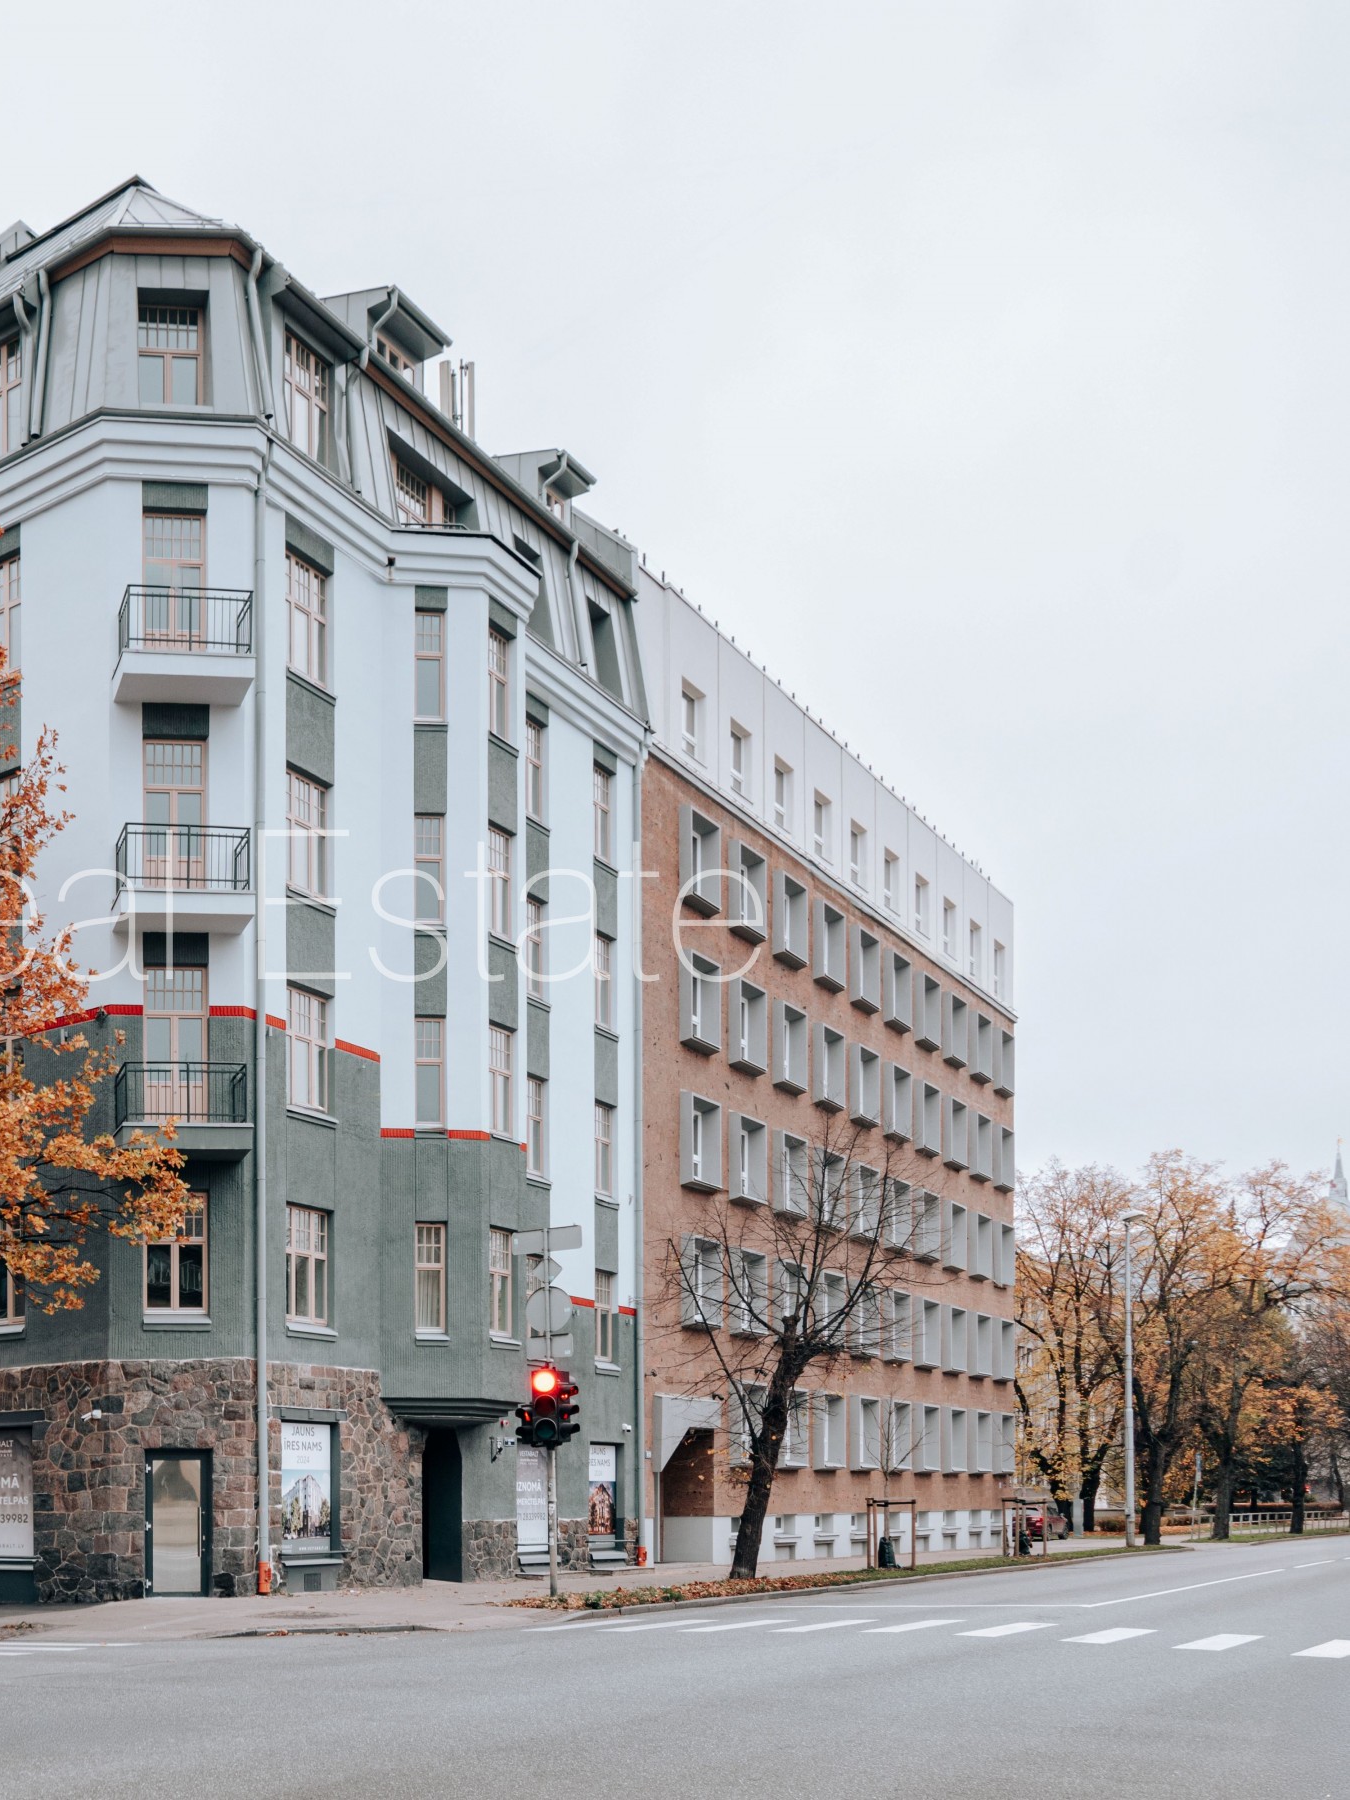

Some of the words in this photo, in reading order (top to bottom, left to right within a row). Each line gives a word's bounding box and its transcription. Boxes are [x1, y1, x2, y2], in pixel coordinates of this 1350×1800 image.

[291, 1425, 315, 1437] JAUNS
[283, 1437, 301, 1452] ĪRES
[301, 1441, 323, 1452] NAMS
[296, 1455, 310, 1464] 2024
[516, 1479, 542, 1492] IZNOMĀ
